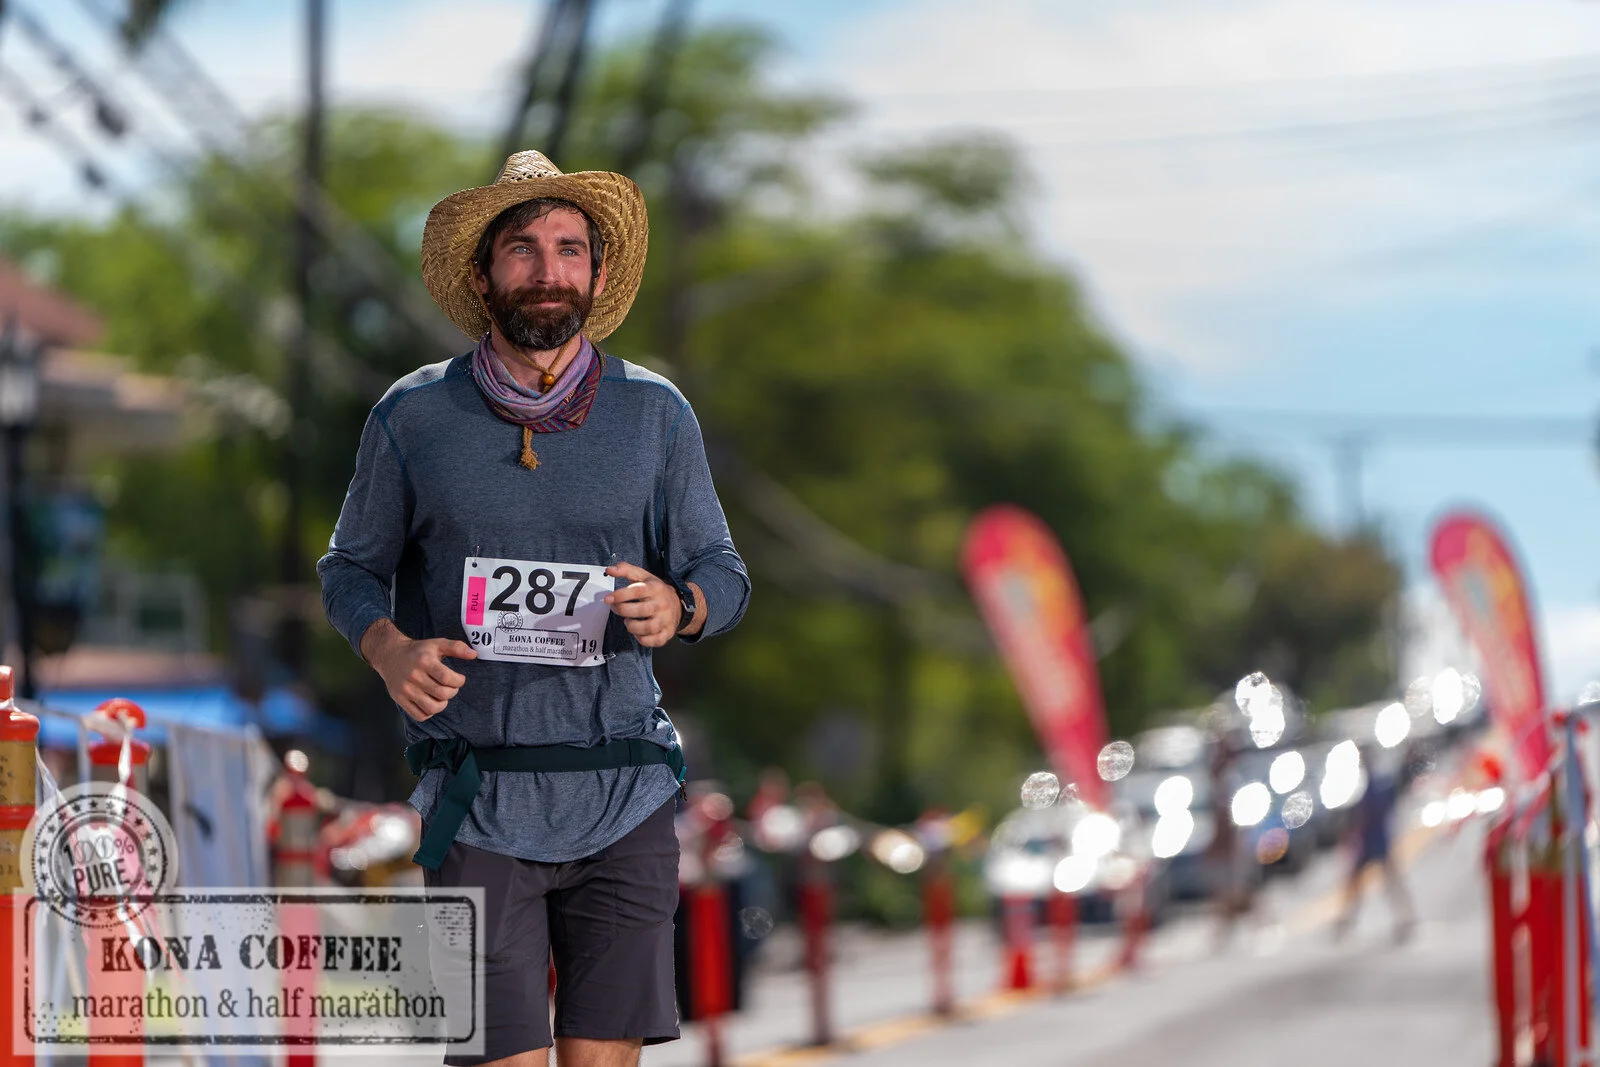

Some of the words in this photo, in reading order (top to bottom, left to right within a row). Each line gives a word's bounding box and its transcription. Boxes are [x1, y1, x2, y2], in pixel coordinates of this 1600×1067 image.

[488, 565, 590, 617] 287
[471, 592, 479, 611] FULL
[472, 631, 492, 646] 20
[508, 634, 533, 644] KONA
[534, 636, 566, 646] COFFEE
[502, 644, 529, 653] marathon
[535, 646, 547, 654] half
[547, 647, 573, 656] marathon
[580, 639, 598, 654] 19
